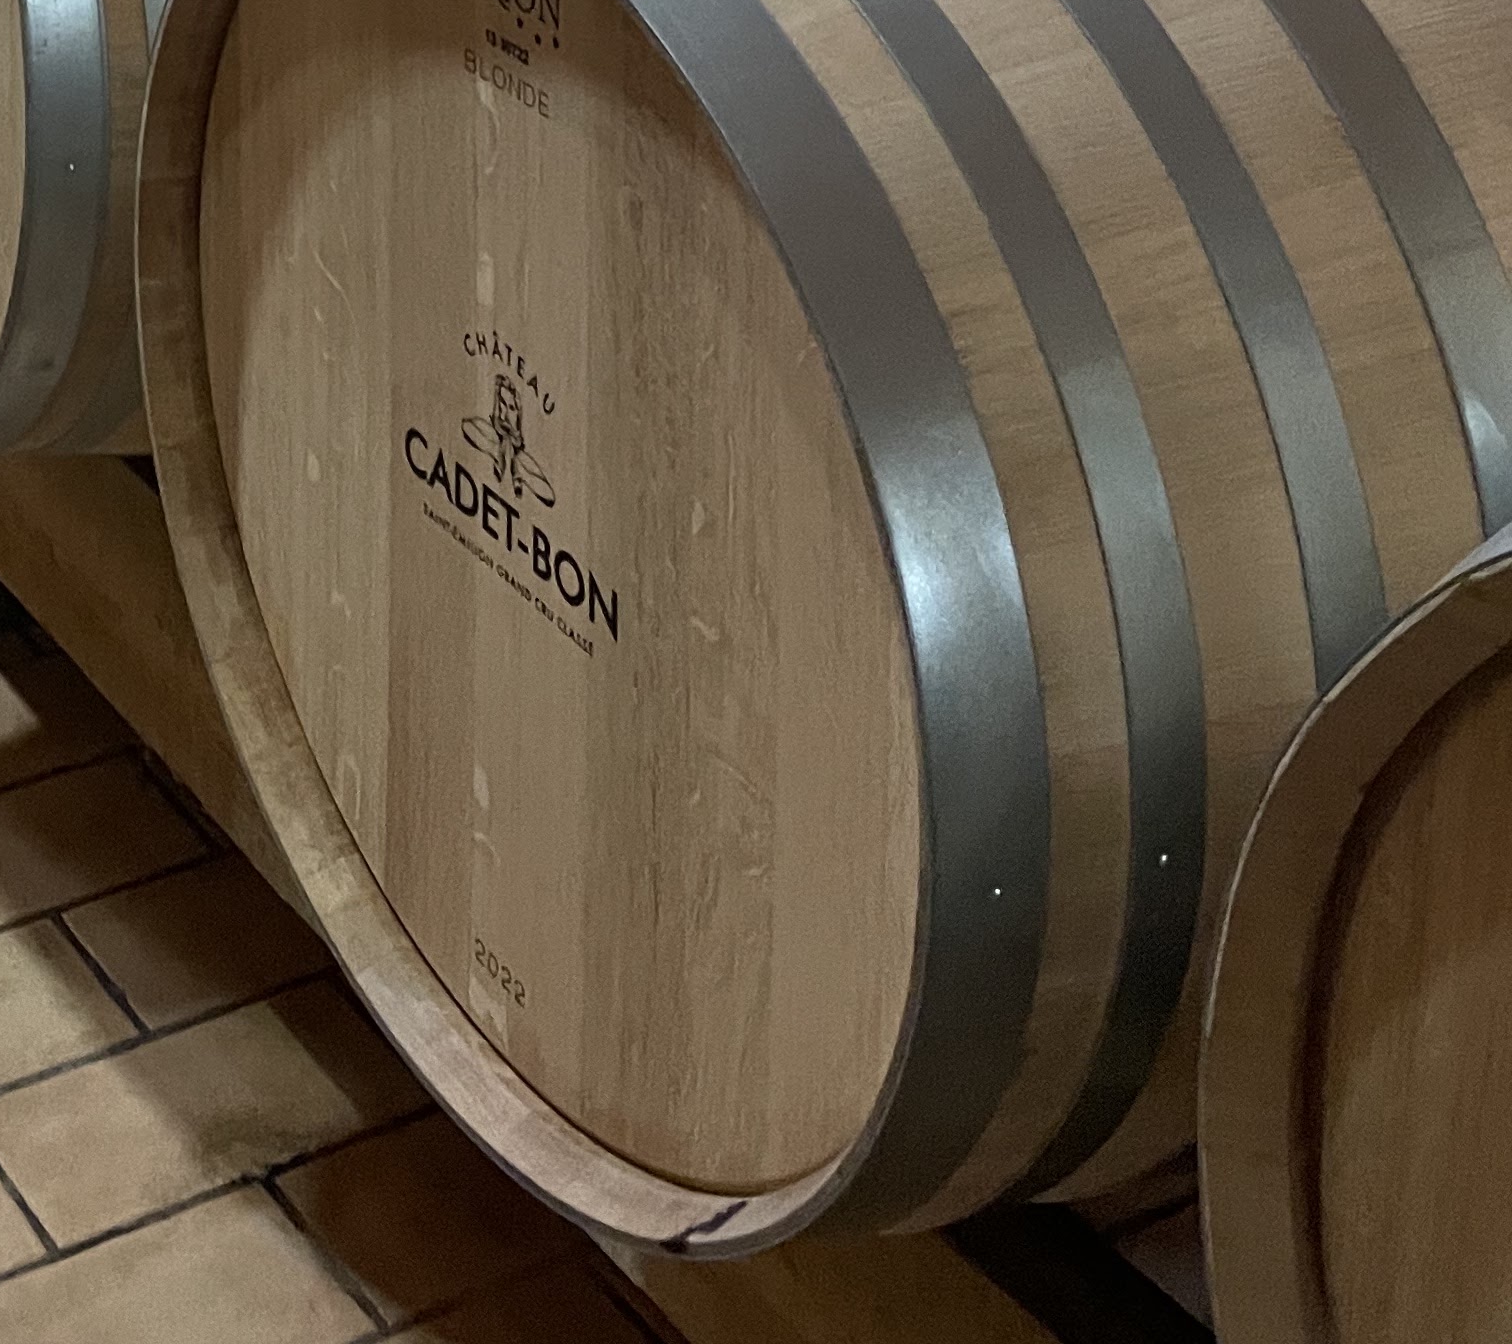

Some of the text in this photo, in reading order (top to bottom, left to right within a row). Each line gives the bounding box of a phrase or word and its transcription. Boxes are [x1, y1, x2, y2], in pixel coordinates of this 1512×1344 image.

[464, 47, 550, 119] BLONDE
[463, 330, 555, 415] CHÂTEAU
[405, 427, 619, 643] CADET-BON
[496, 564, 532, 602] GRAND
[535, 597, 554, 623] CRU
[474, 938, 526, 1009] 2022
